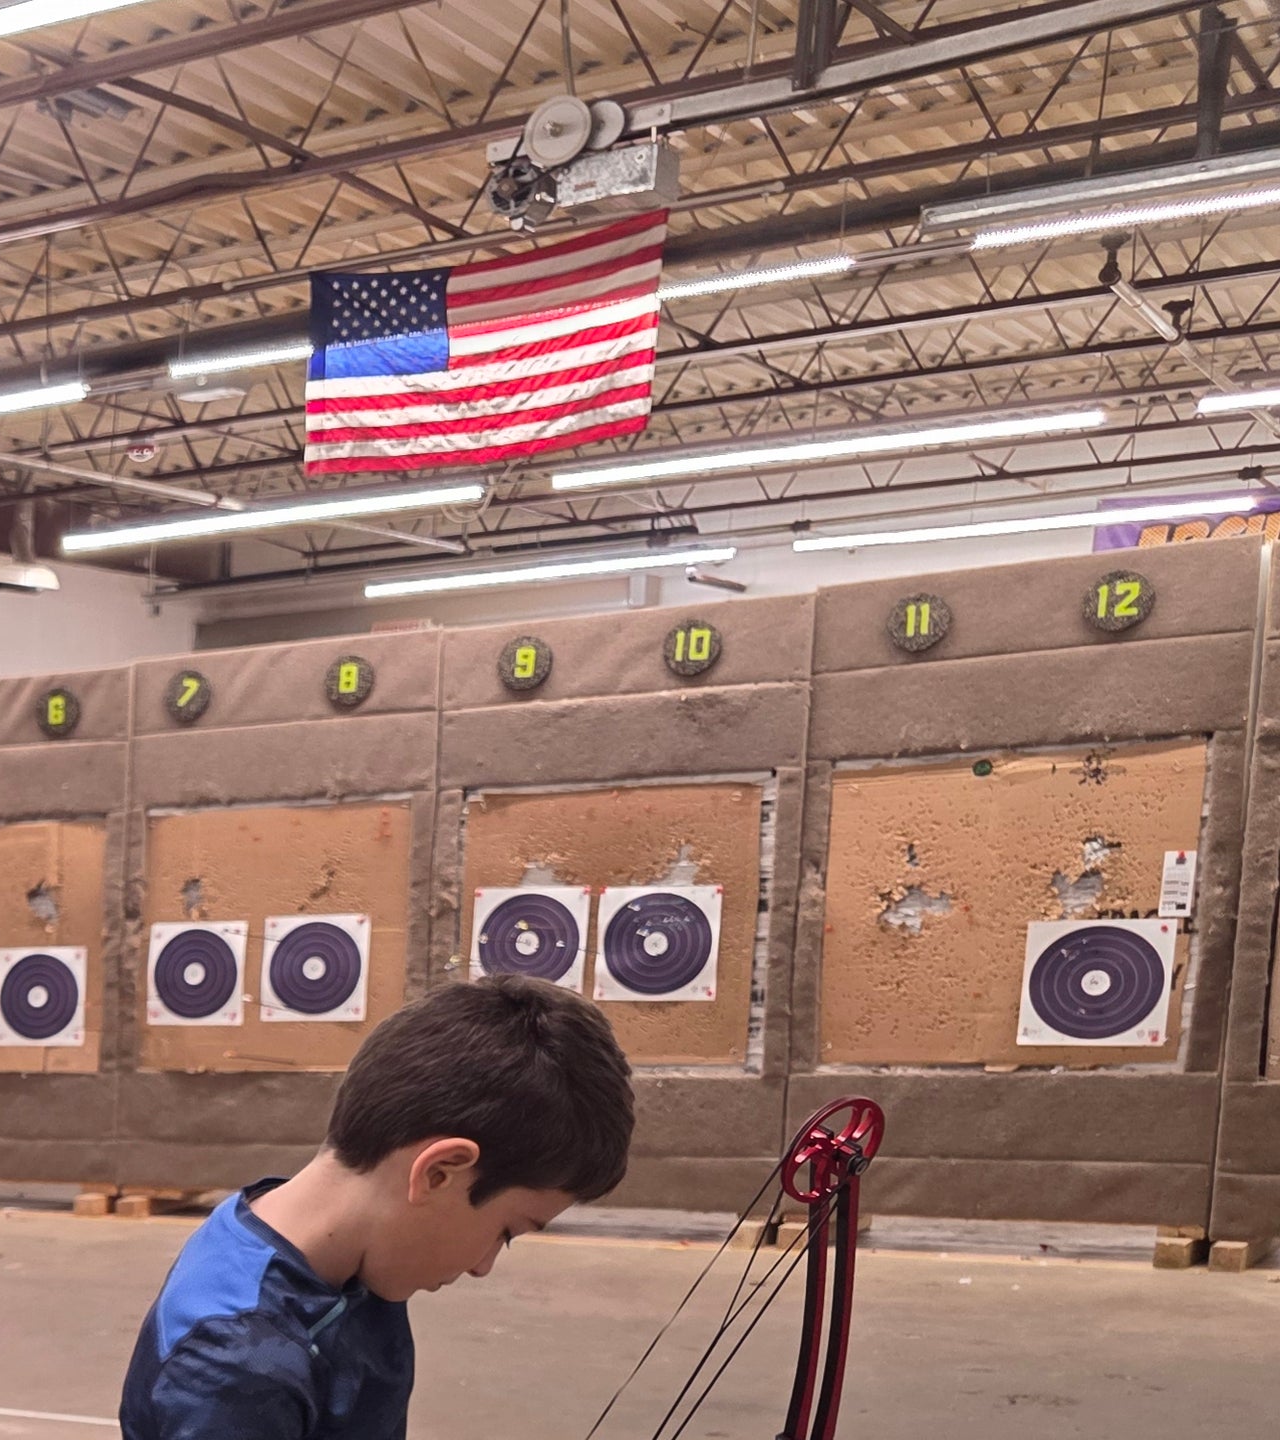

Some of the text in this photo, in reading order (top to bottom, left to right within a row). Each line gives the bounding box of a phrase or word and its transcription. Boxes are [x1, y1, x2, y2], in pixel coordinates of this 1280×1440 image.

[1096, 579, 1141, 616] 12
[905, 604, 928, 634] 11
[674, 626, 711, 662] 10
[337, 661, 359, 694] 8
[513, 645, 537, 678] 9
[47, 693, 66, 725] 6
[177, 677, 200, 708] 7
